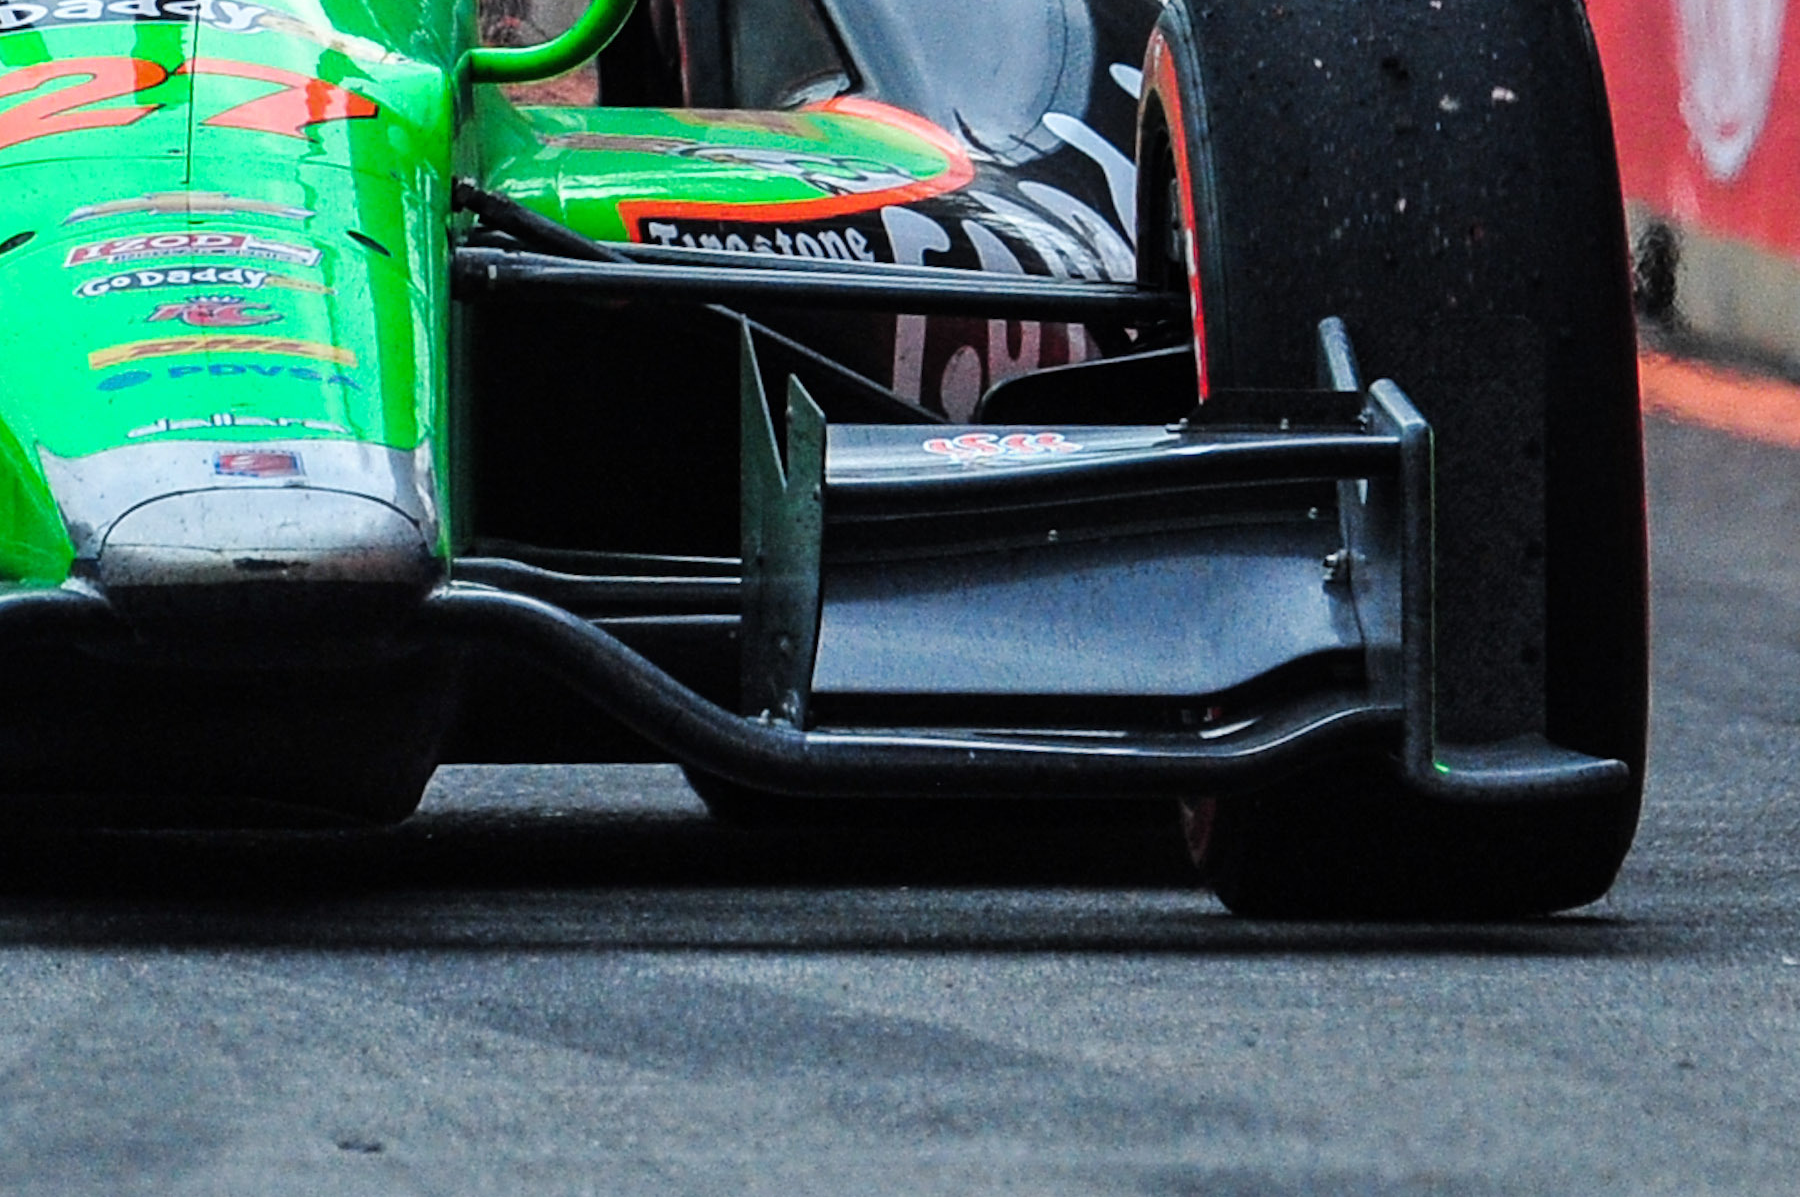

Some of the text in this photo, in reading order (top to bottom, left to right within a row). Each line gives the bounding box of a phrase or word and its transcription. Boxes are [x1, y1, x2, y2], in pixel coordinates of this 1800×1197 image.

[83, 234, 233, 259] IZOD
[81, 273, 131, 296] Go
[139, 268, 268, 289] Daddy
[167, 362, 363, 392] PDVSA
